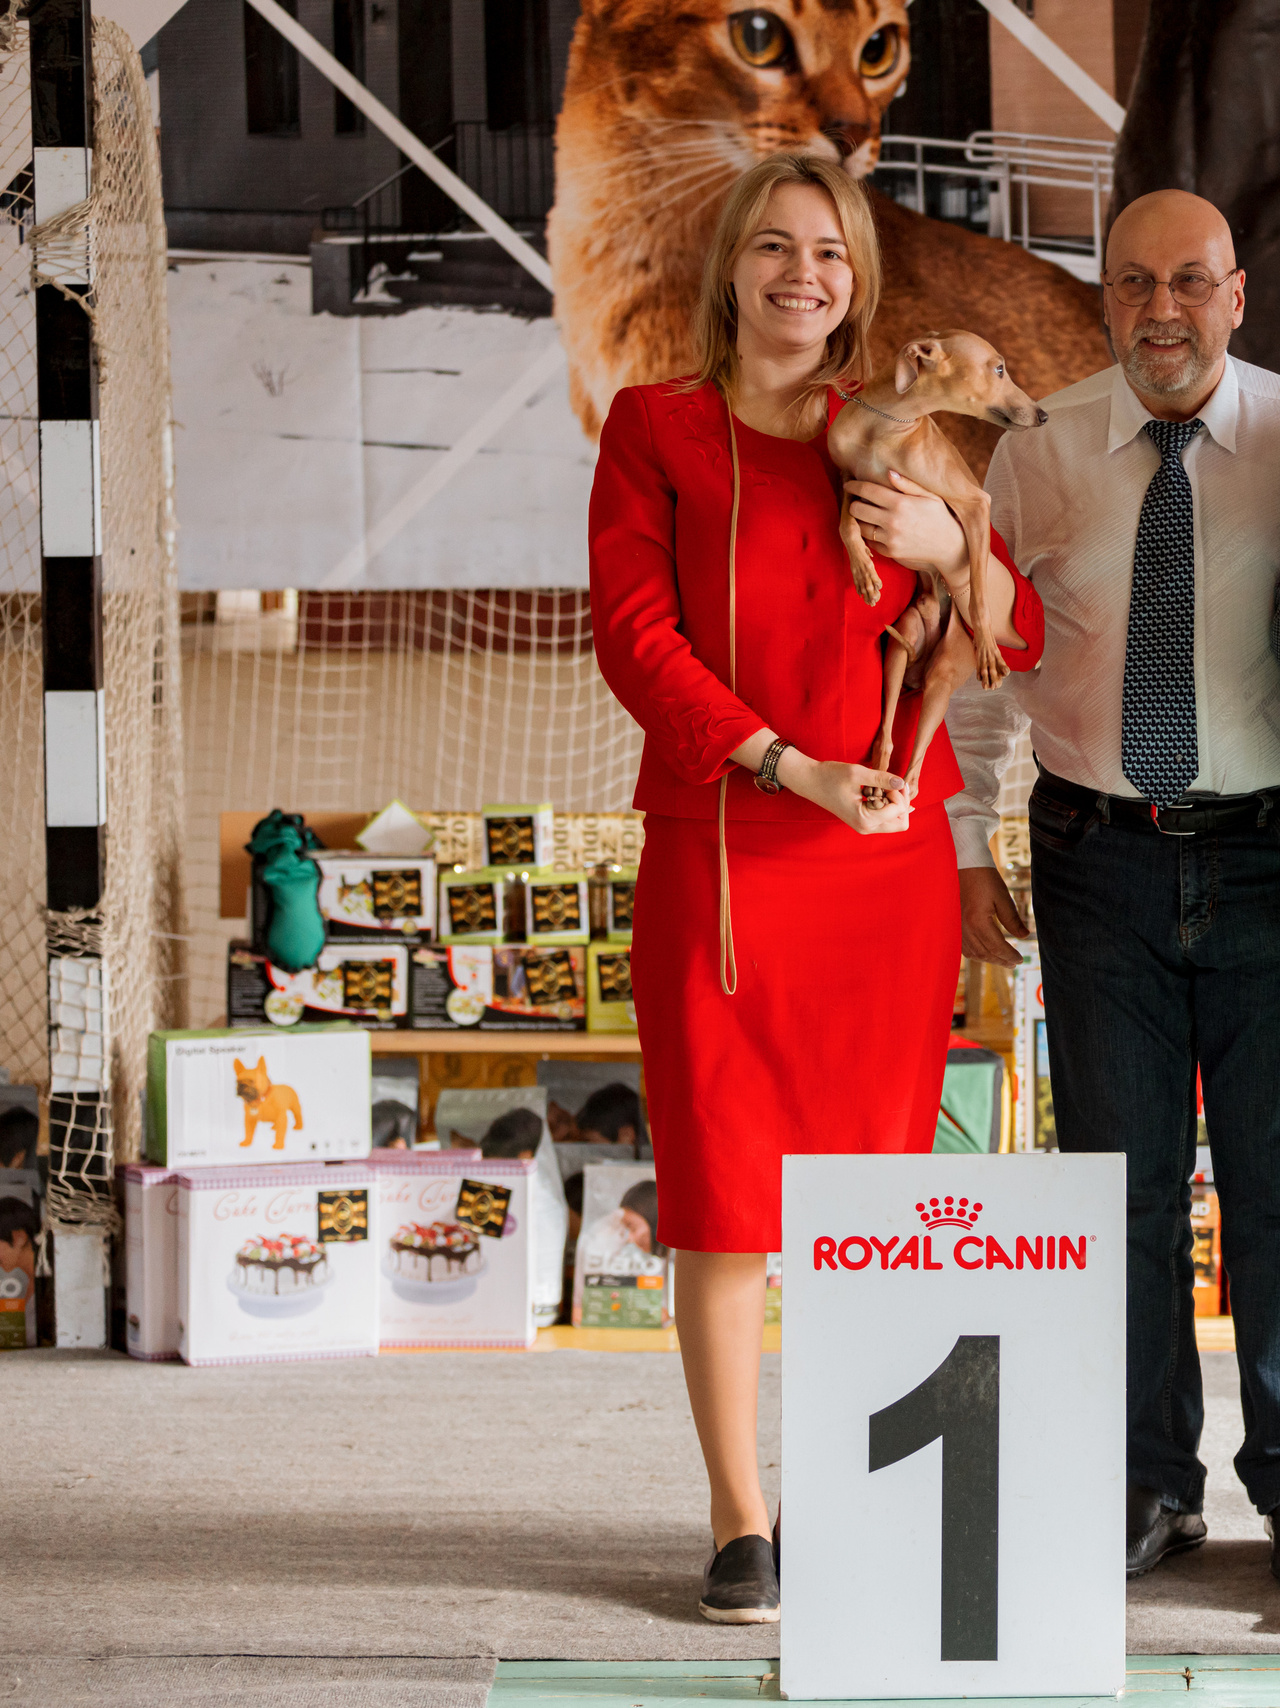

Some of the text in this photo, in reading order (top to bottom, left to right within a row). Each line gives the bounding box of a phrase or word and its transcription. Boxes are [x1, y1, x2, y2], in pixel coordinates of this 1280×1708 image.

[213, 1191, 258, 1222] Cake
[813, 1235, 1086, 1270] ROYAL CANIN
[868, 1334, 1000, 1661] 1
